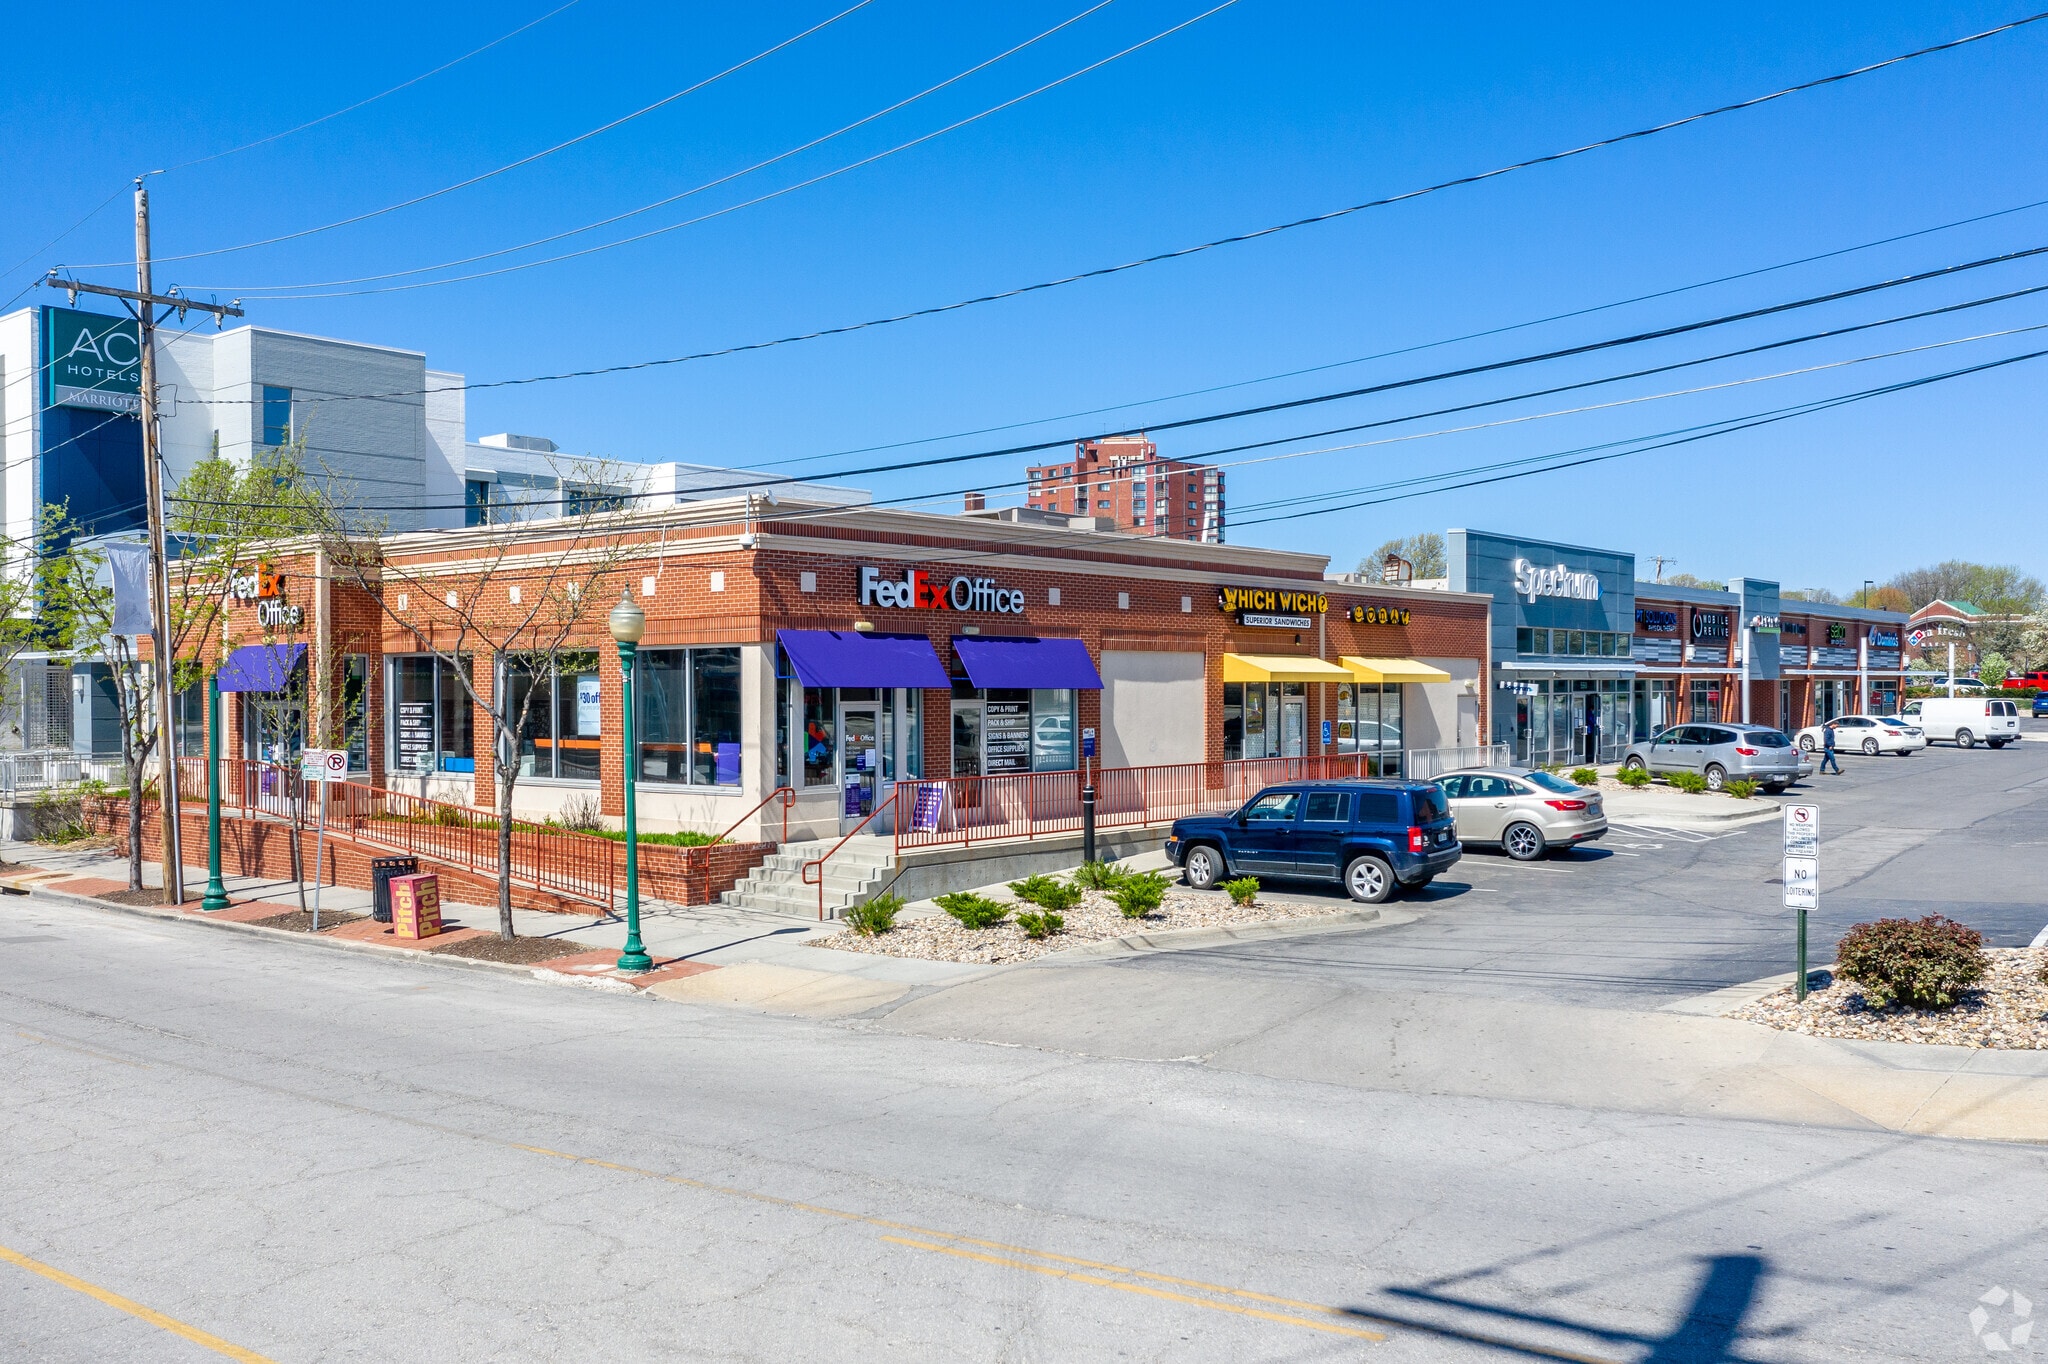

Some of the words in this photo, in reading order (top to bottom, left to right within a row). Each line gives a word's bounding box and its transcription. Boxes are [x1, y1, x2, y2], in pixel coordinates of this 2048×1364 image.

[68, 328, 138, 366] AC
[67, 365, 139, 382] HOTELS
[1514, 559, 1599, 604] Spectrum
[861, 566, 950, 610] FedEx
[950, 576, 1025, 614] Office
[1223, 587, 1275, 610] WHICH
[257, 599, 300, 626] Office
[1645, 610, 1677, 625] SOLUTIONS
[1703, 615, 1729, 625] MOBILE
[1245, 616, 1272, 625] SUPERIOR
[1274, 618, 1310, 628] SANDWICHES
[1703, 627, 1729, 637] REVIVE
[860, 734, 874, 742] Office
[988, 732, 1002, 740] SIGNS
[1004, 744, 1024, 752] SUPPLIES
[1794, 870, 1806, 880] NO
[1786, 887, 1816, 896] LOITERING
[395, 884, 414, 938] Pitch
[415, 880, 440, 937] Pitch
